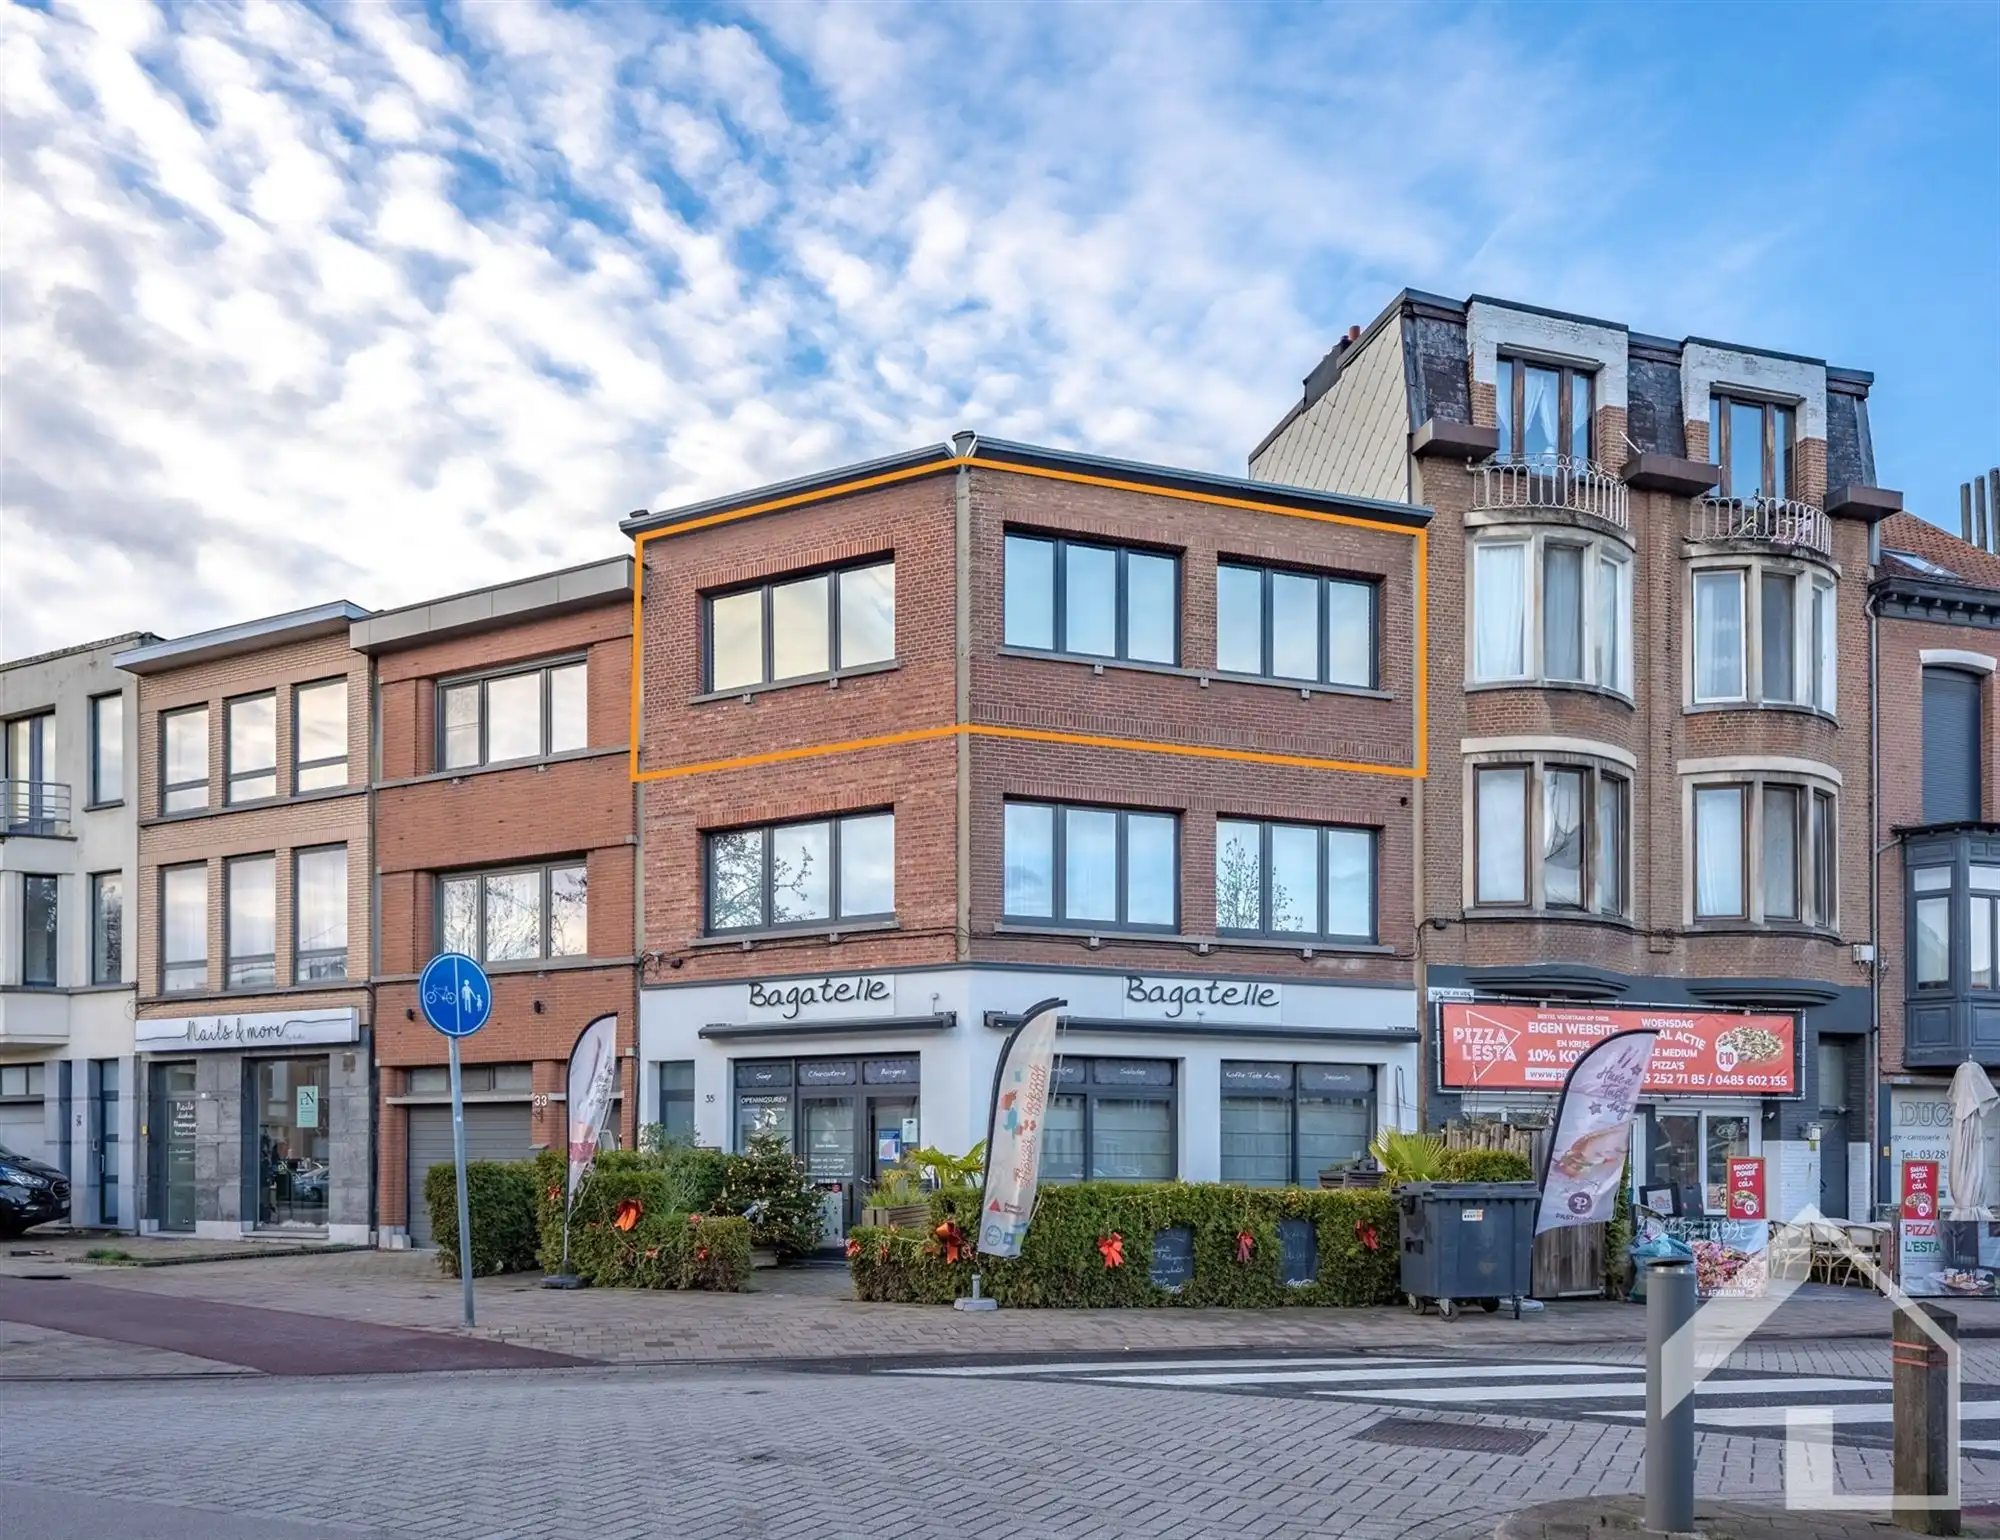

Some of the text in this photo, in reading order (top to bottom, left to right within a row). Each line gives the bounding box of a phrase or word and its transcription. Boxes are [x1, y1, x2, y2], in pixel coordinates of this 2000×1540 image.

[748, 978, 890, 1019] Bagatelle
[1126, 976, 1280, 1018] Bagatelle
[1528, 1022, 1619, 1036] EIGEN WEBSITE
[1641, 1018, 1694, 1028] WOENSDAG
[185, 1018, 230, 1043] Nails
[247, 1025, 286, 1038] more
[1453, 1028, 1508, 1045] PIZZA
[1674, 1030, 1707, 1050] ACTIE
[1527, 1048, 1556, 1062] 10%
[1662, 1048, 1698, 1058] MEDIUM
[1718, 1052, 1735, 1065] €10
[1652, 1060, 1685, 1070] PIZZA'S
[1597, 1065, 1625, 1084] Have
[1653, 1073, 1673, 1084] 252
[1677, 1074, 1688, 1085] 71
[1691, 1074, 1705, 1085] 85
[1715, 1074, 1744, 1086] 0485
[1747, 1075, 1768, 1086] 602
[1770, 1075, 1788, 1087] 135
[535, 1095, 547, 1106] 33
[741, 1096, 788, 1104] OPENINGSUREN
[1738, 1180, 1754, 1188] COLA
[1905, 1224, 1938, 1236] PIZZA
[1905, 1240, 1941, 1253] L'ESTA
